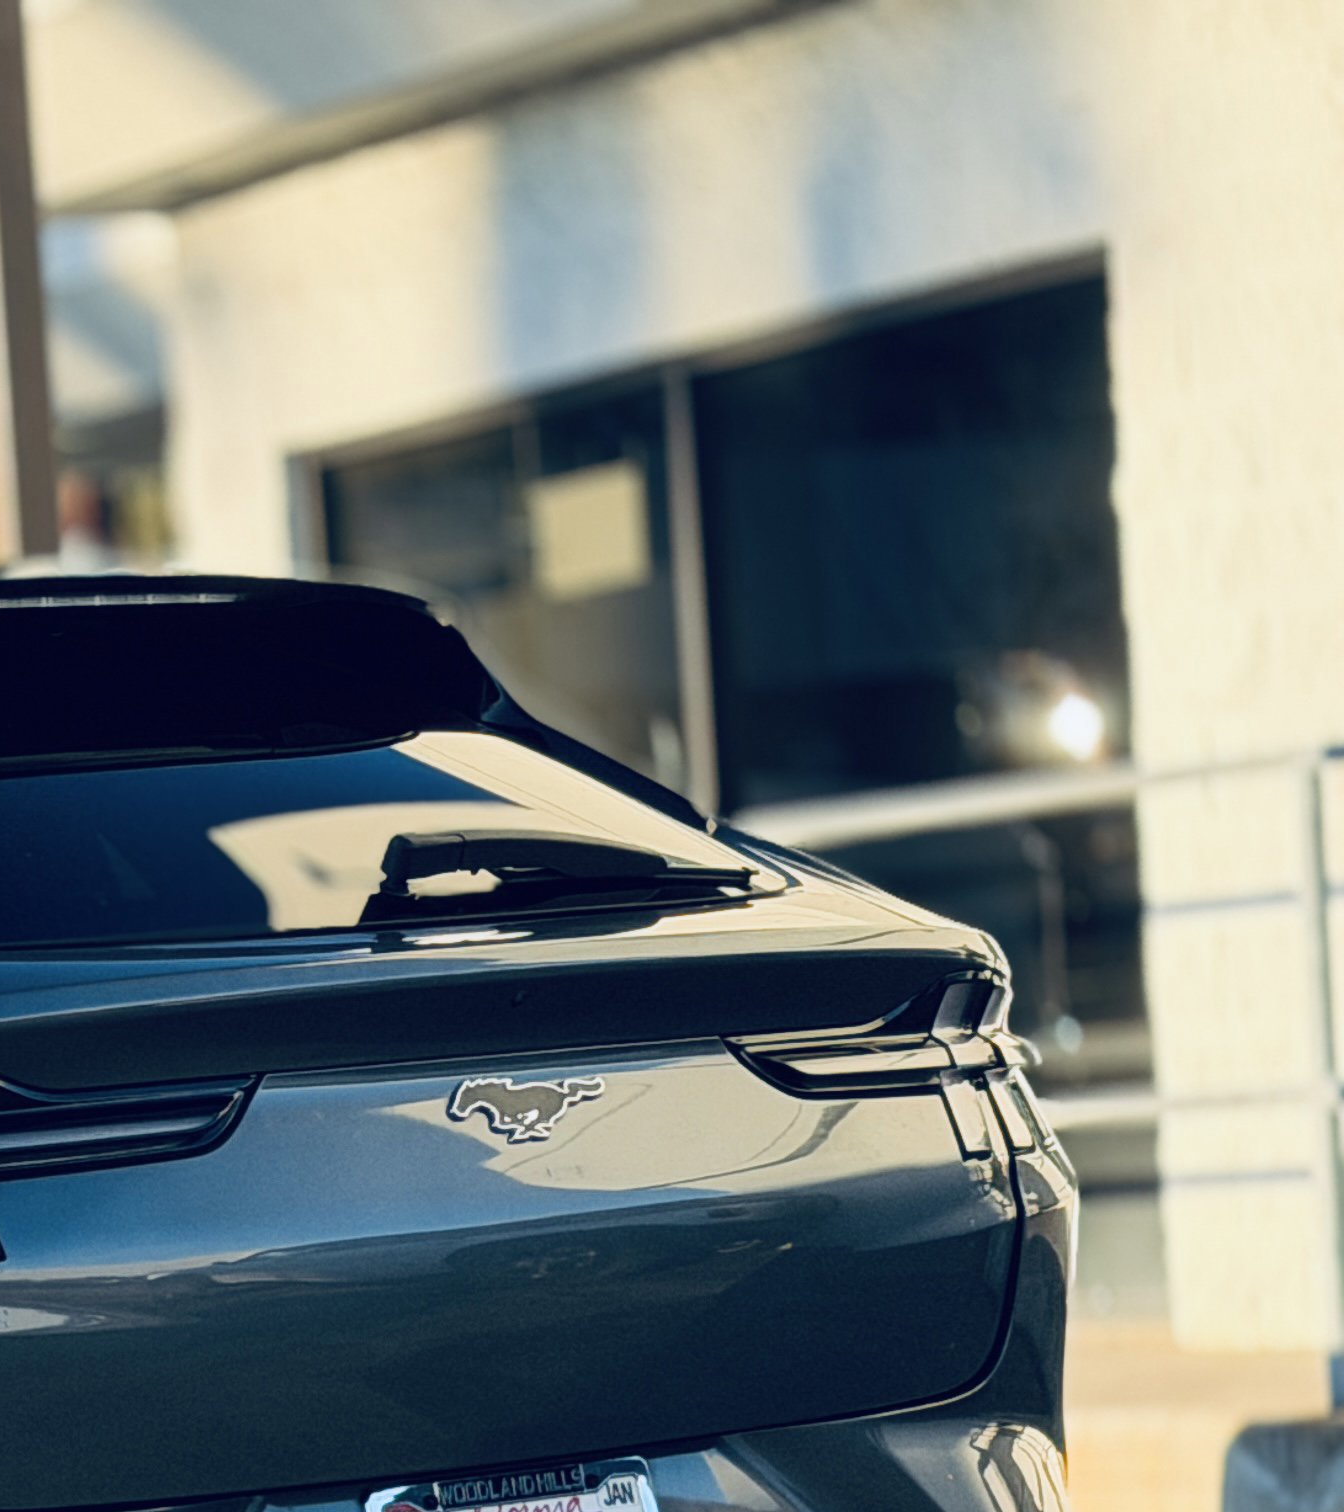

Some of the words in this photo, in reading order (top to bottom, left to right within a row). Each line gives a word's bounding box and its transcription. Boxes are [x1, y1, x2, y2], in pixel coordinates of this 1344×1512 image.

[441, 1475, 535, 1505] WOODLAND
[536, 1468, 584, 1493] HILLS
[602, 1481, 635, 1507] JAN
